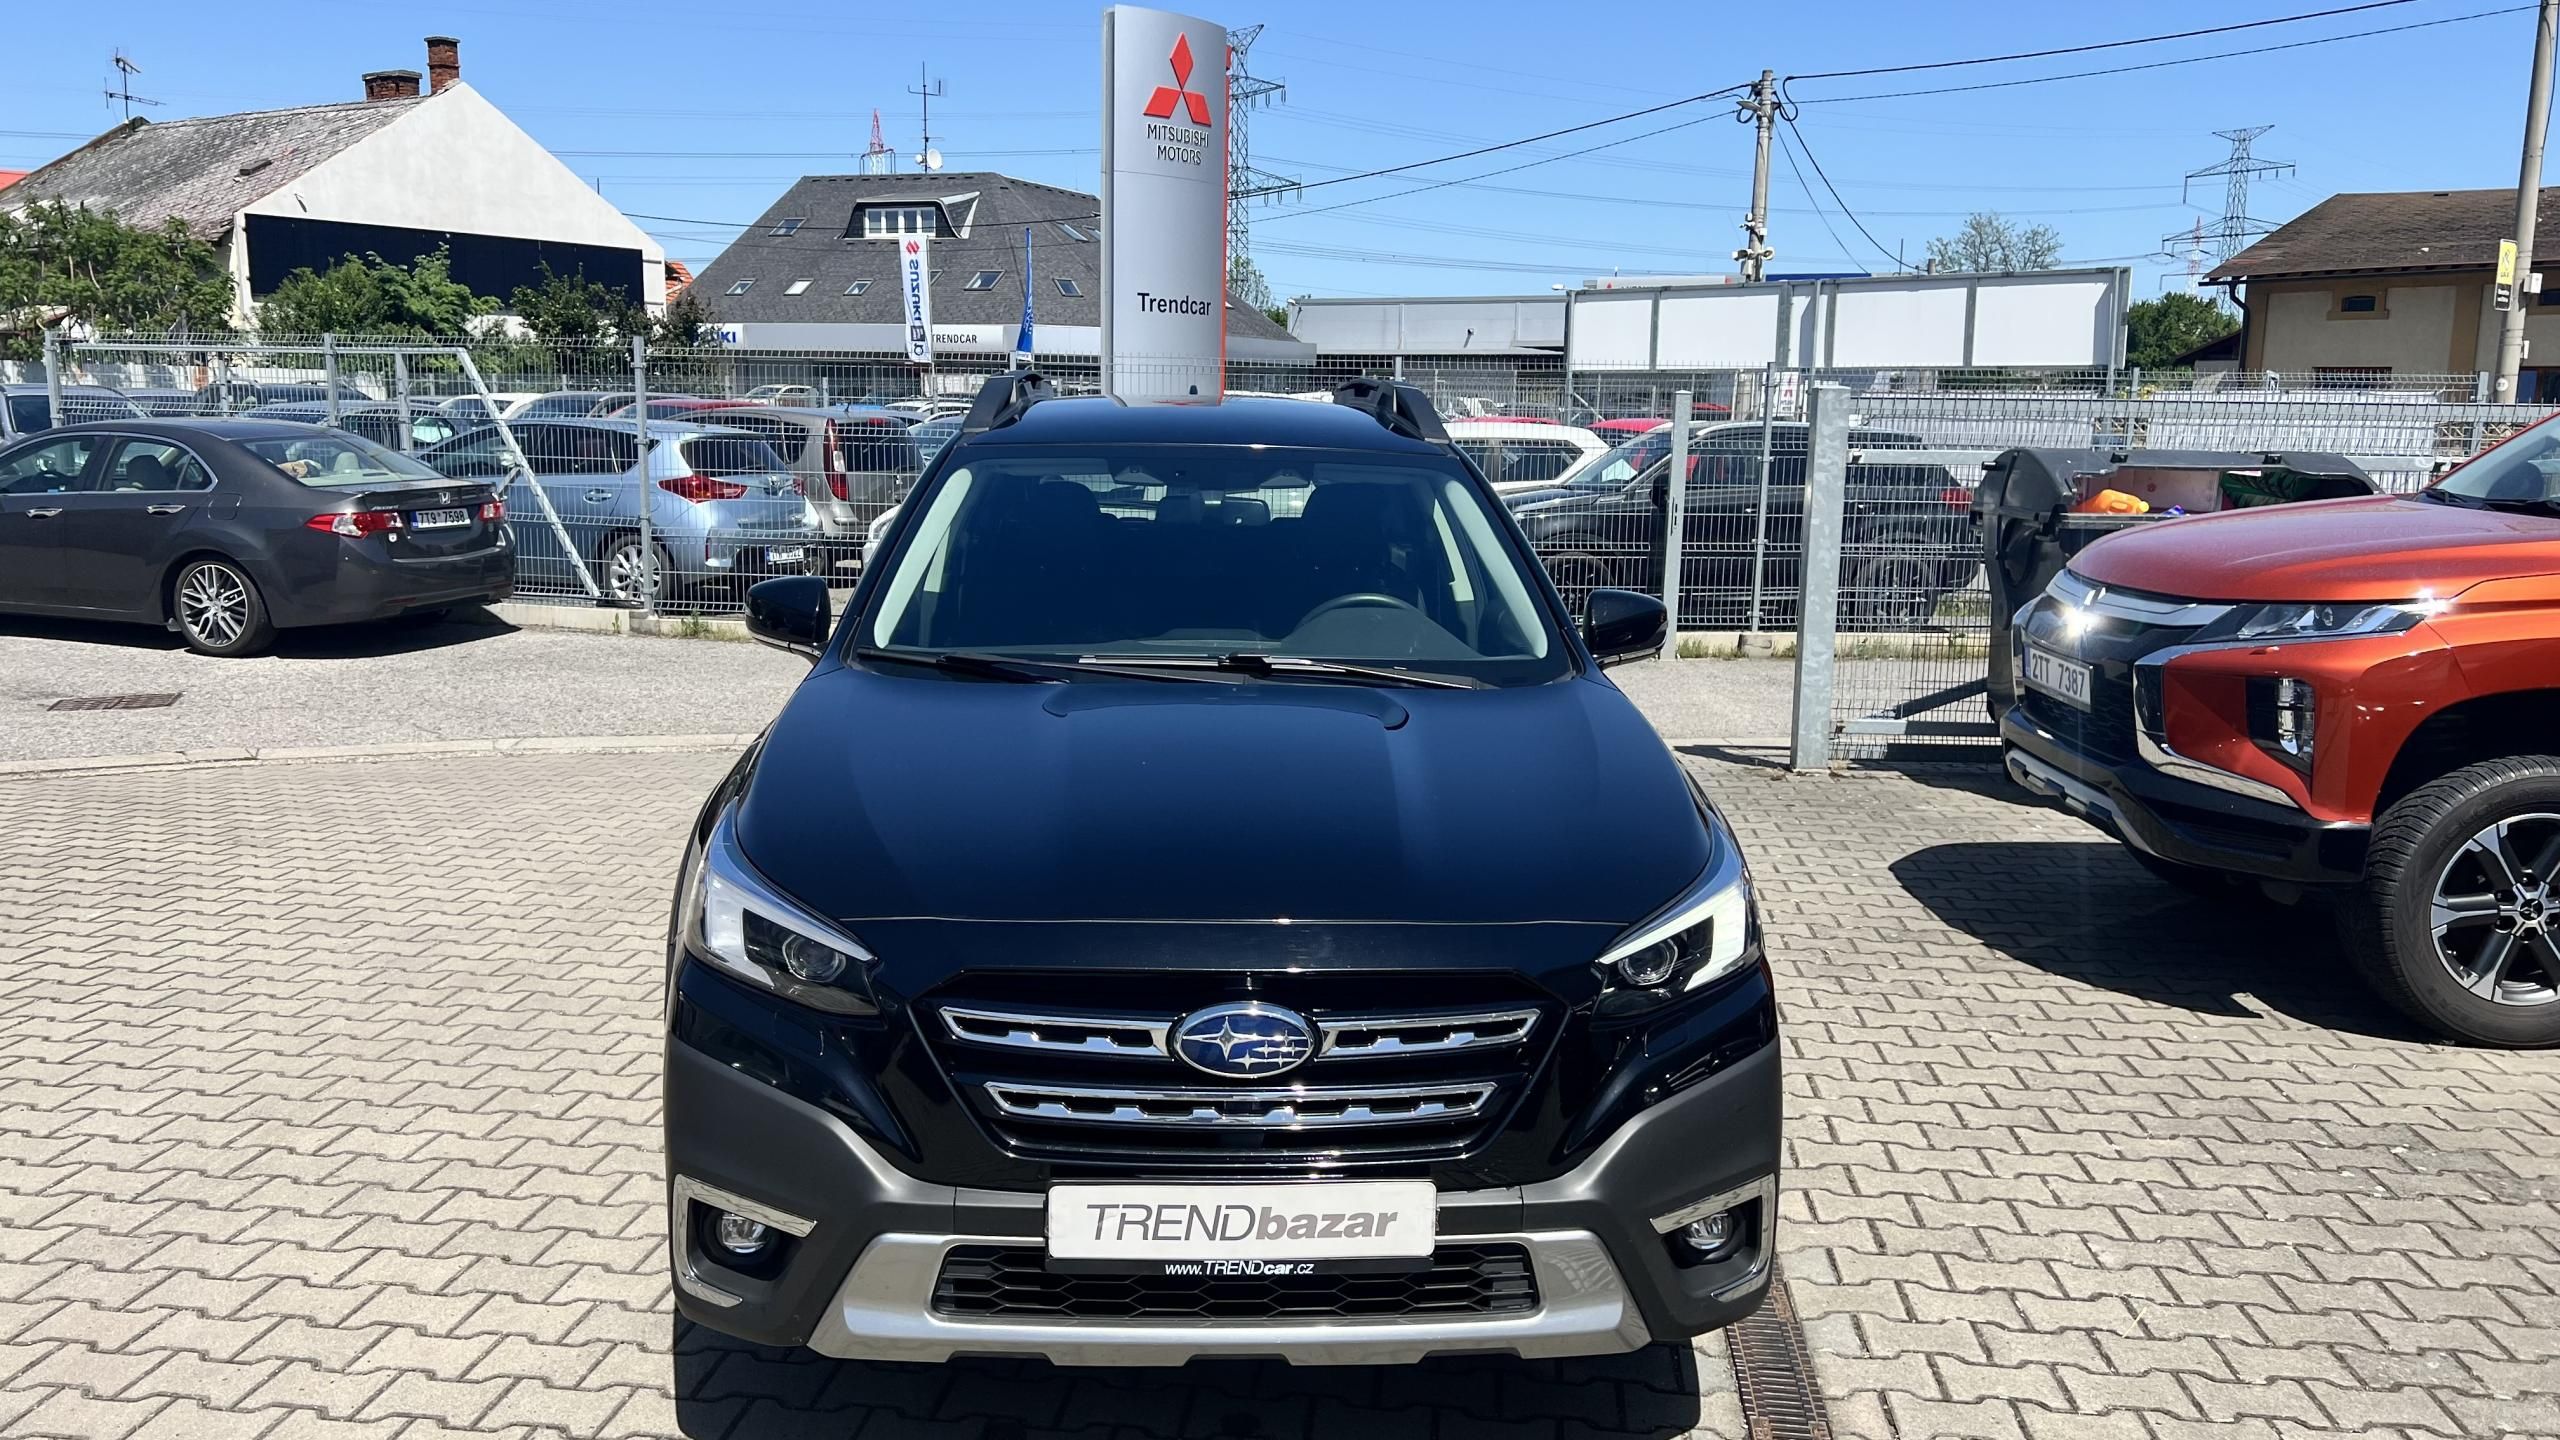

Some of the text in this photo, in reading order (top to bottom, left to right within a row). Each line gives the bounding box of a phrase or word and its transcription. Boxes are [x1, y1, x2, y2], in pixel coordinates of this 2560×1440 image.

[1147, 124, 1209, 147] MITSUBISHI
[1157, 145, 1202, 165] MOTORS
[1137, 292, 1212, 316] Trendcar
[932, 334, 978, 344] TRENDCAR
[418, 510, 465, 524] 7T9 7598
[2032, 653, 2085, 698] 2TT 7387
[1087, 1204, 1398, 1241] TRENDbazar
[1165, 1260, 1314, 1276] www.TRENDcar.cz
